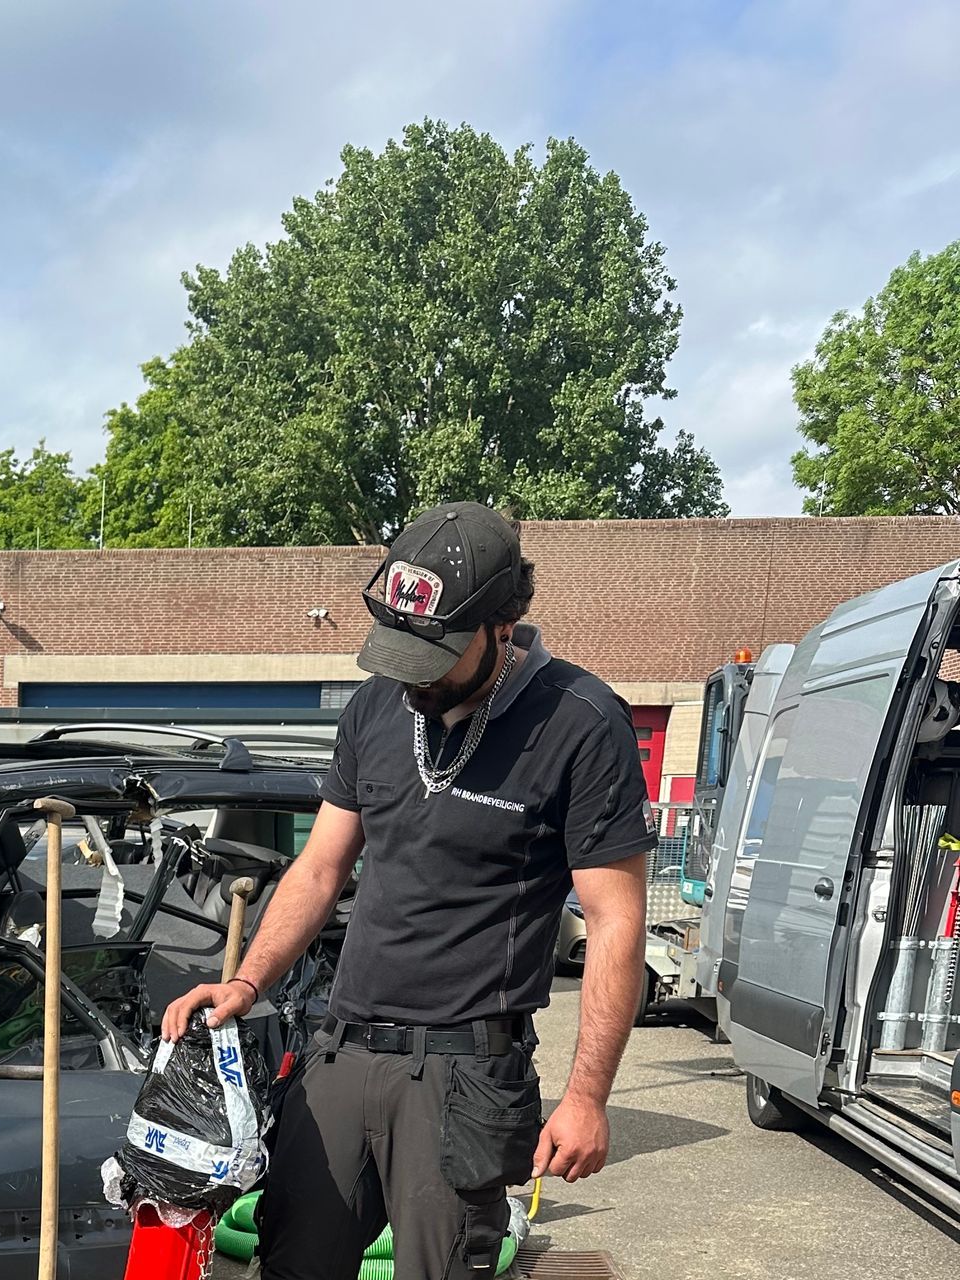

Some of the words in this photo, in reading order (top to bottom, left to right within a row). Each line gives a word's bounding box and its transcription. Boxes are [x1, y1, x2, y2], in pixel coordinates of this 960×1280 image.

[451, 787, 462, 798] RH
[461, 790, 525, 813] BRANDBEVEILIGING
[218, 1046, 243, 1088] AVK
[145, 1126, 168, 1153] AVK
